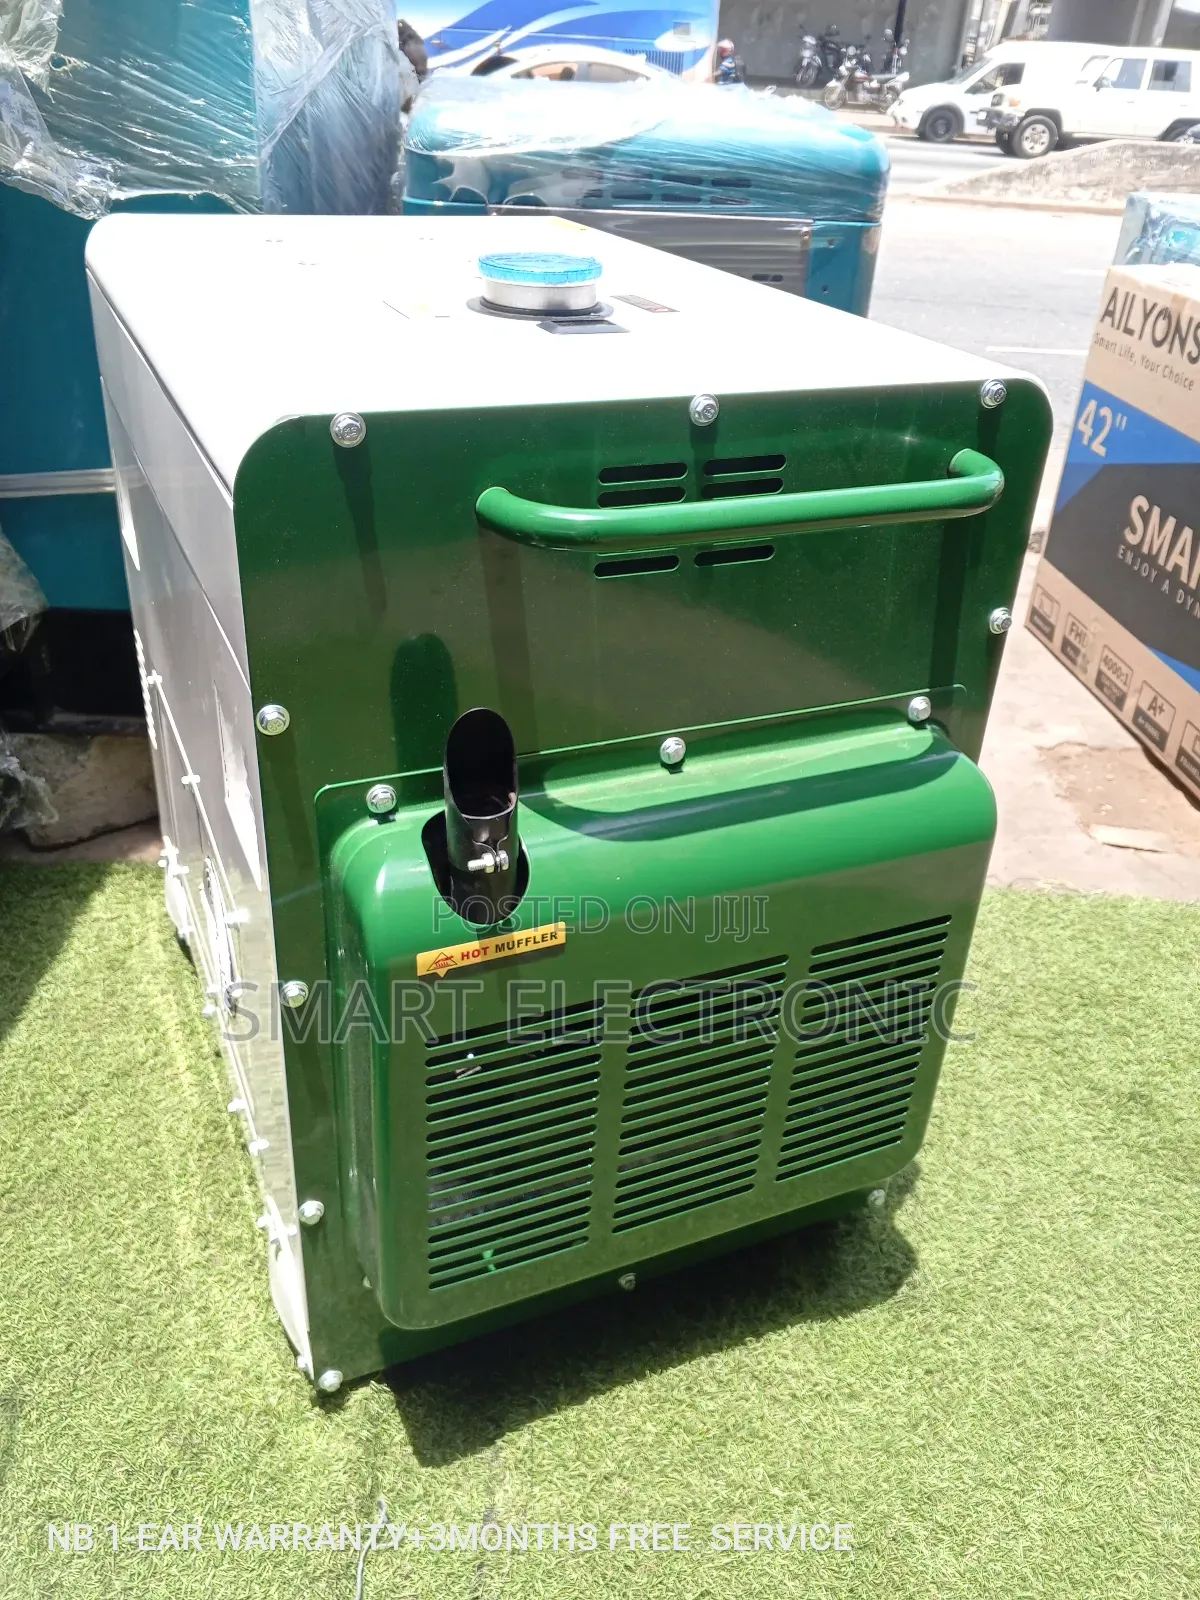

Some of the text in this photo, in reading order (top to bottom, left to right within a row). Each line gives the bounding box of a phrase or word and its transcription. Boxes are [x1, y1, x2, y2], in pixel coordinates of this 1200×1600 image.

[1099, 287, 1200, 365] AILYONS
[1094, 333, 1195, 391] Smart Life, Your Choice
[1117, 544, 1158, 583] ENJOY
[1161, 579, 1170, 594] A
[1147, 695, 1165, 718] A+
[461, 931, 559, 961] HOT MUFFLER
